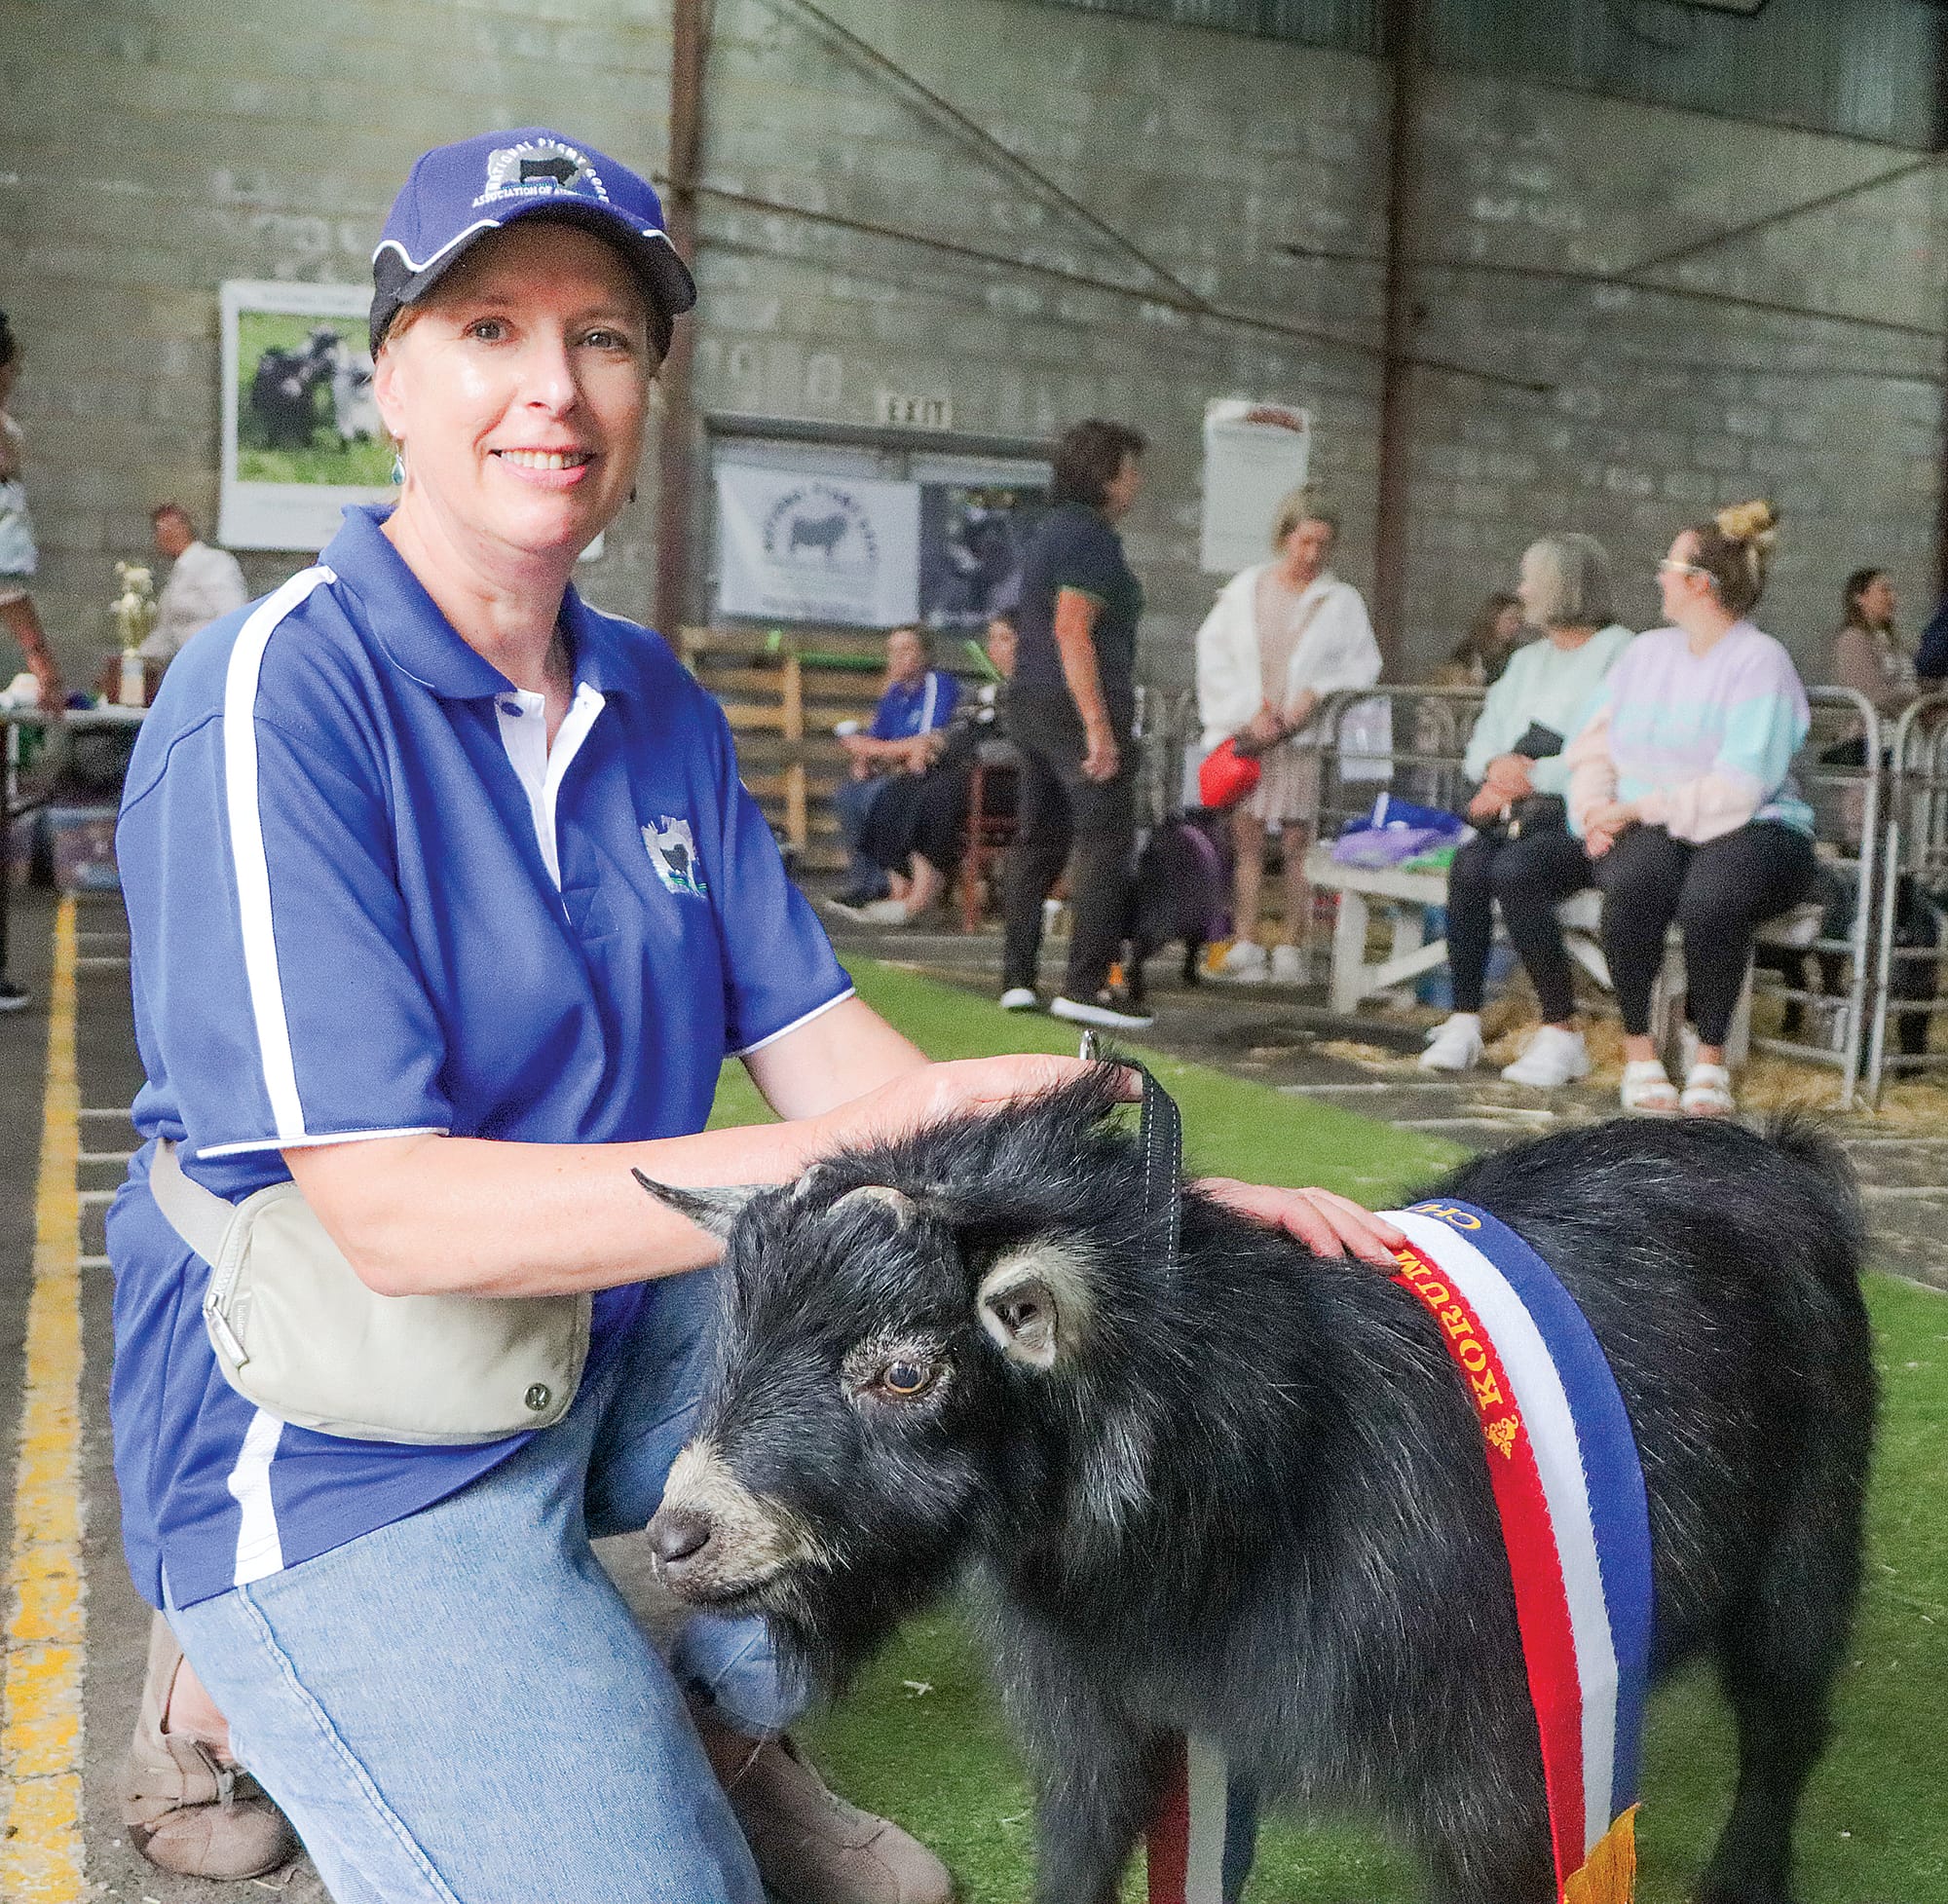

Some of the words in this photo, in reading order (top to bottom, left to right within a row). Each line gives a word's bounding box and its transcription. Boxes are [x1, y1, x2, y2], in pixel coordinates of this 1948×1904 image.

[538, 137, 586, 164] PYGMY
[471, 186, 536, 208] ASSOCIATION
[538, 185, 554, 195] OF
[1415, 1204, 1481, 1231] CH
[1395, 1249, 1504, 1410] KORUM
